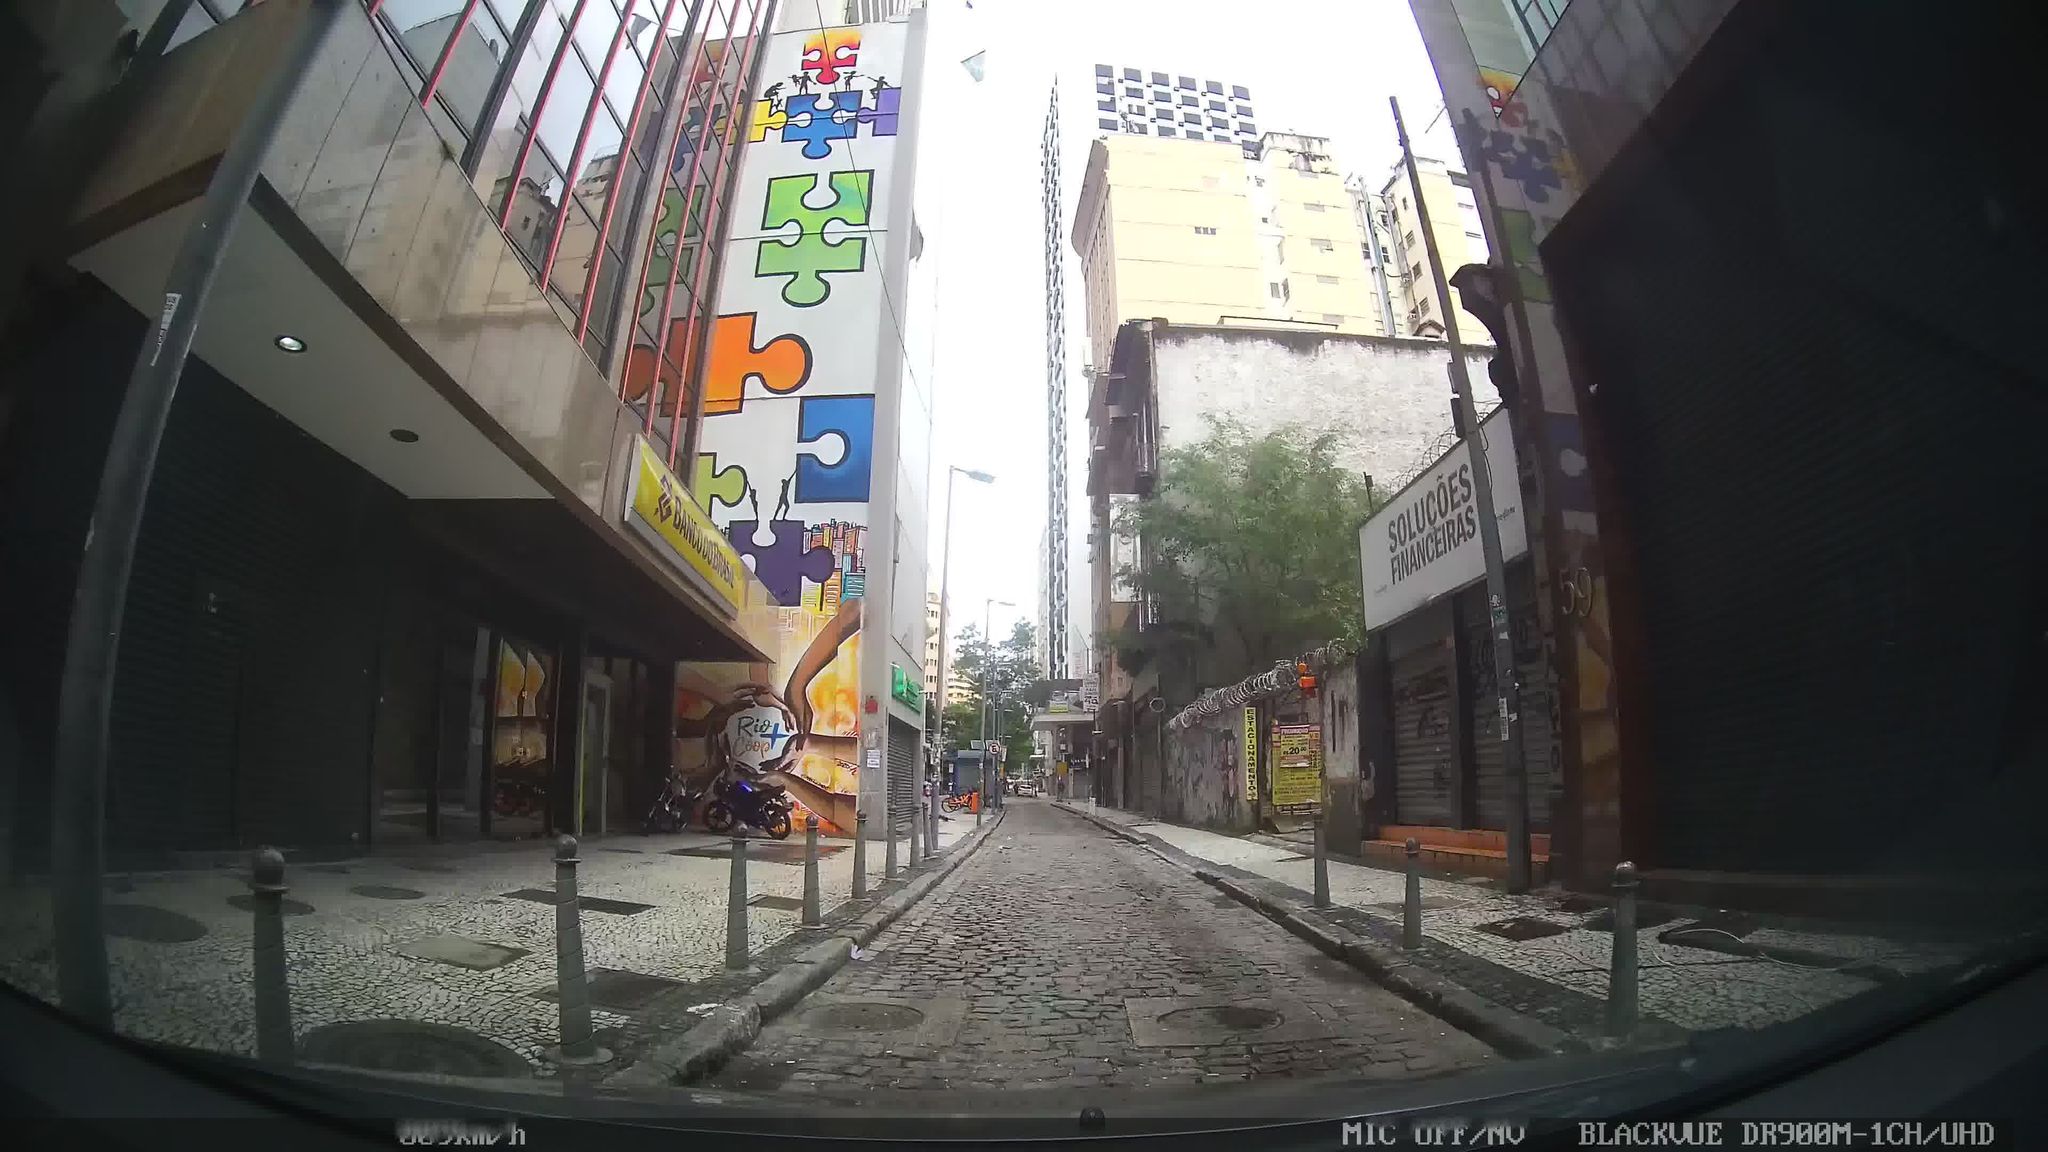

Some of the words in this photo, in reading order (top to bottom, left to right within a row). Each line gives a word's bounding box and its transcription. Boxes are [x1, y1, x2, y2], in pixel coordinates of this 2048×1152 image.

[673, 496, 704, 555] BANCO
[1388, 464, 1472, 553] SOLUÇÕES
[1390, 505, 1476, 585] FINANCEIRAS
[1558, 567, 1593, 617] 59
[737, 715, 773, 737] Rio
